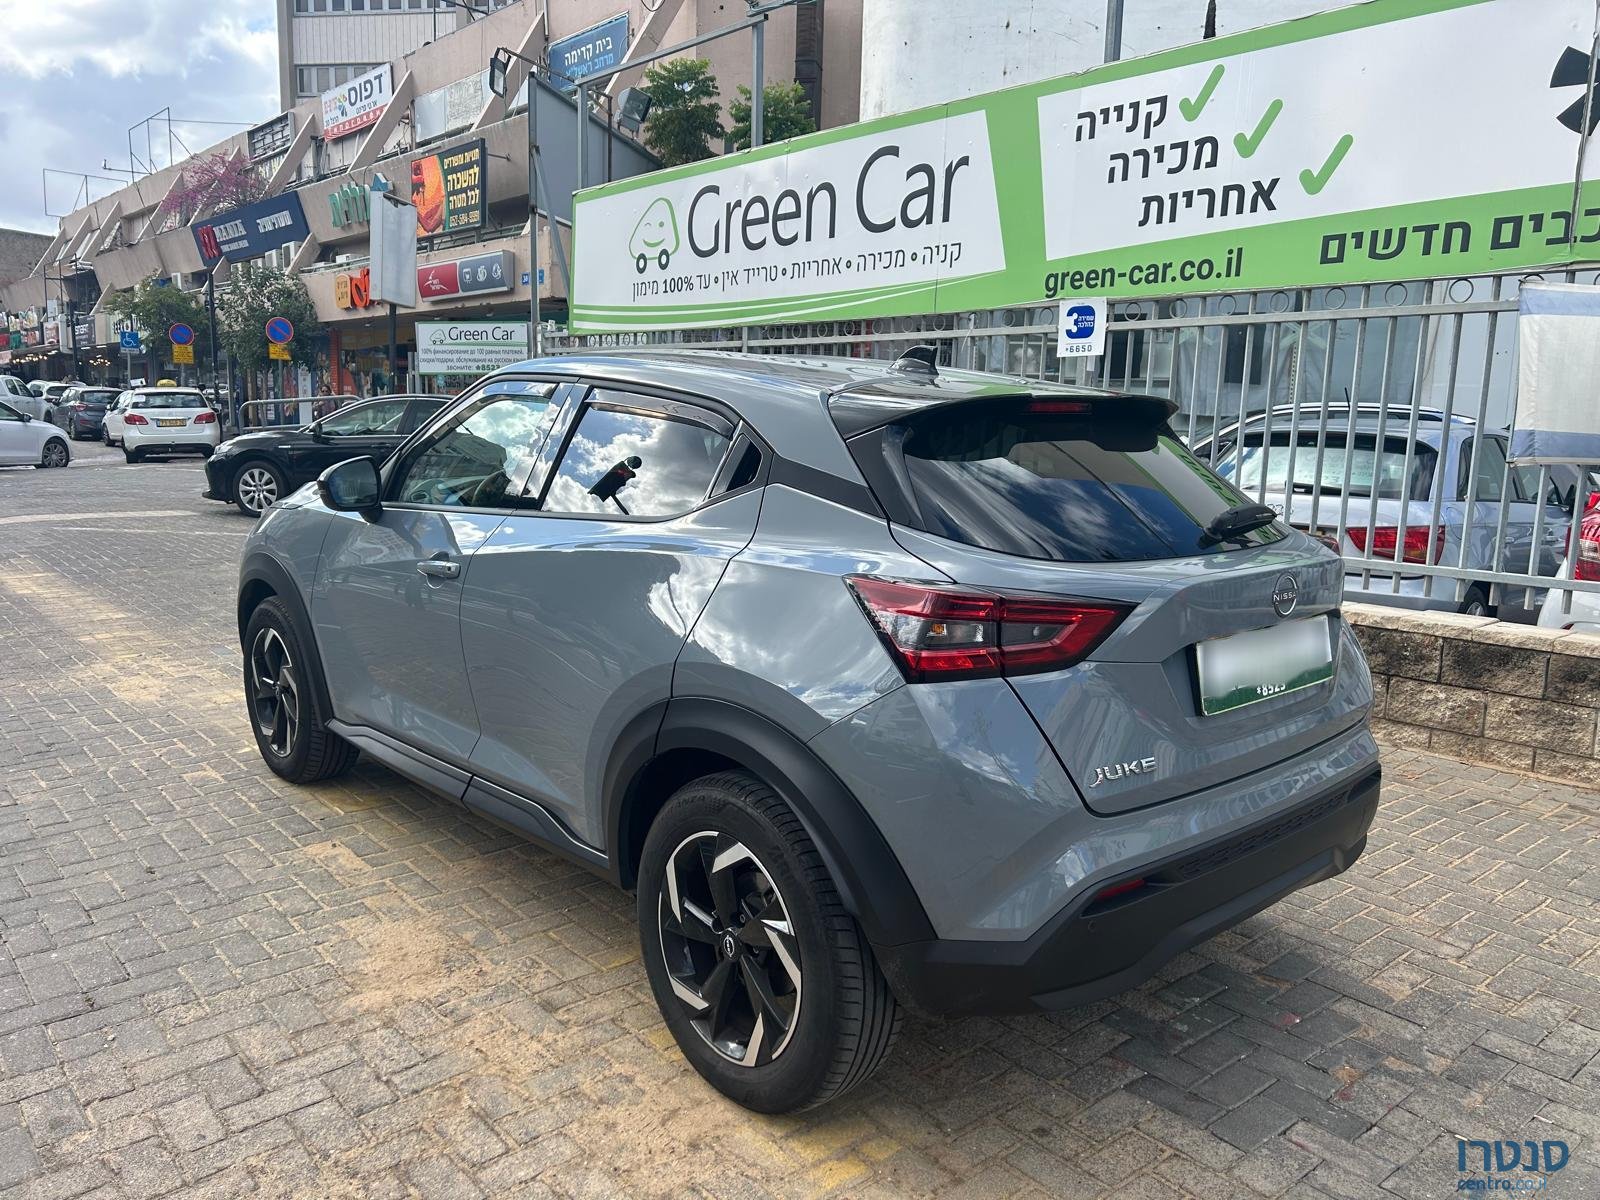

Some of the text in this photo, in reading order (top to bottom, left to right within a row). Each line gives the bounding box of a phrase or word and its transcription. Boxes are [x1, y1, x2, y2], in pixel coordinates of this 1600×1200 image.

[564, 36, 613, 67] בית קדימה
[347, 73, 383, 107] דפוס
[1075, 94, 1168, 142] קנייה
[447, 164, 480, 192] להשכרה
[1107, 135, 1219, 184] מכירה
[449, 188, 480, 210] לכל מטרה
[687, 144, 970, 259] Green Car
[1138, 177, 1281, 227] אחריות
[1319, 221, 1472, 265] חדשים
[632, 241, 963, 303] קניה מכירה אחריות טרייד אין עד 100% מימון
[1044, 247, 1243, 299] green-car.co.il
[448, 326, 515, 341] Green Car
[1089, 756, 1158, 788] JUKE
